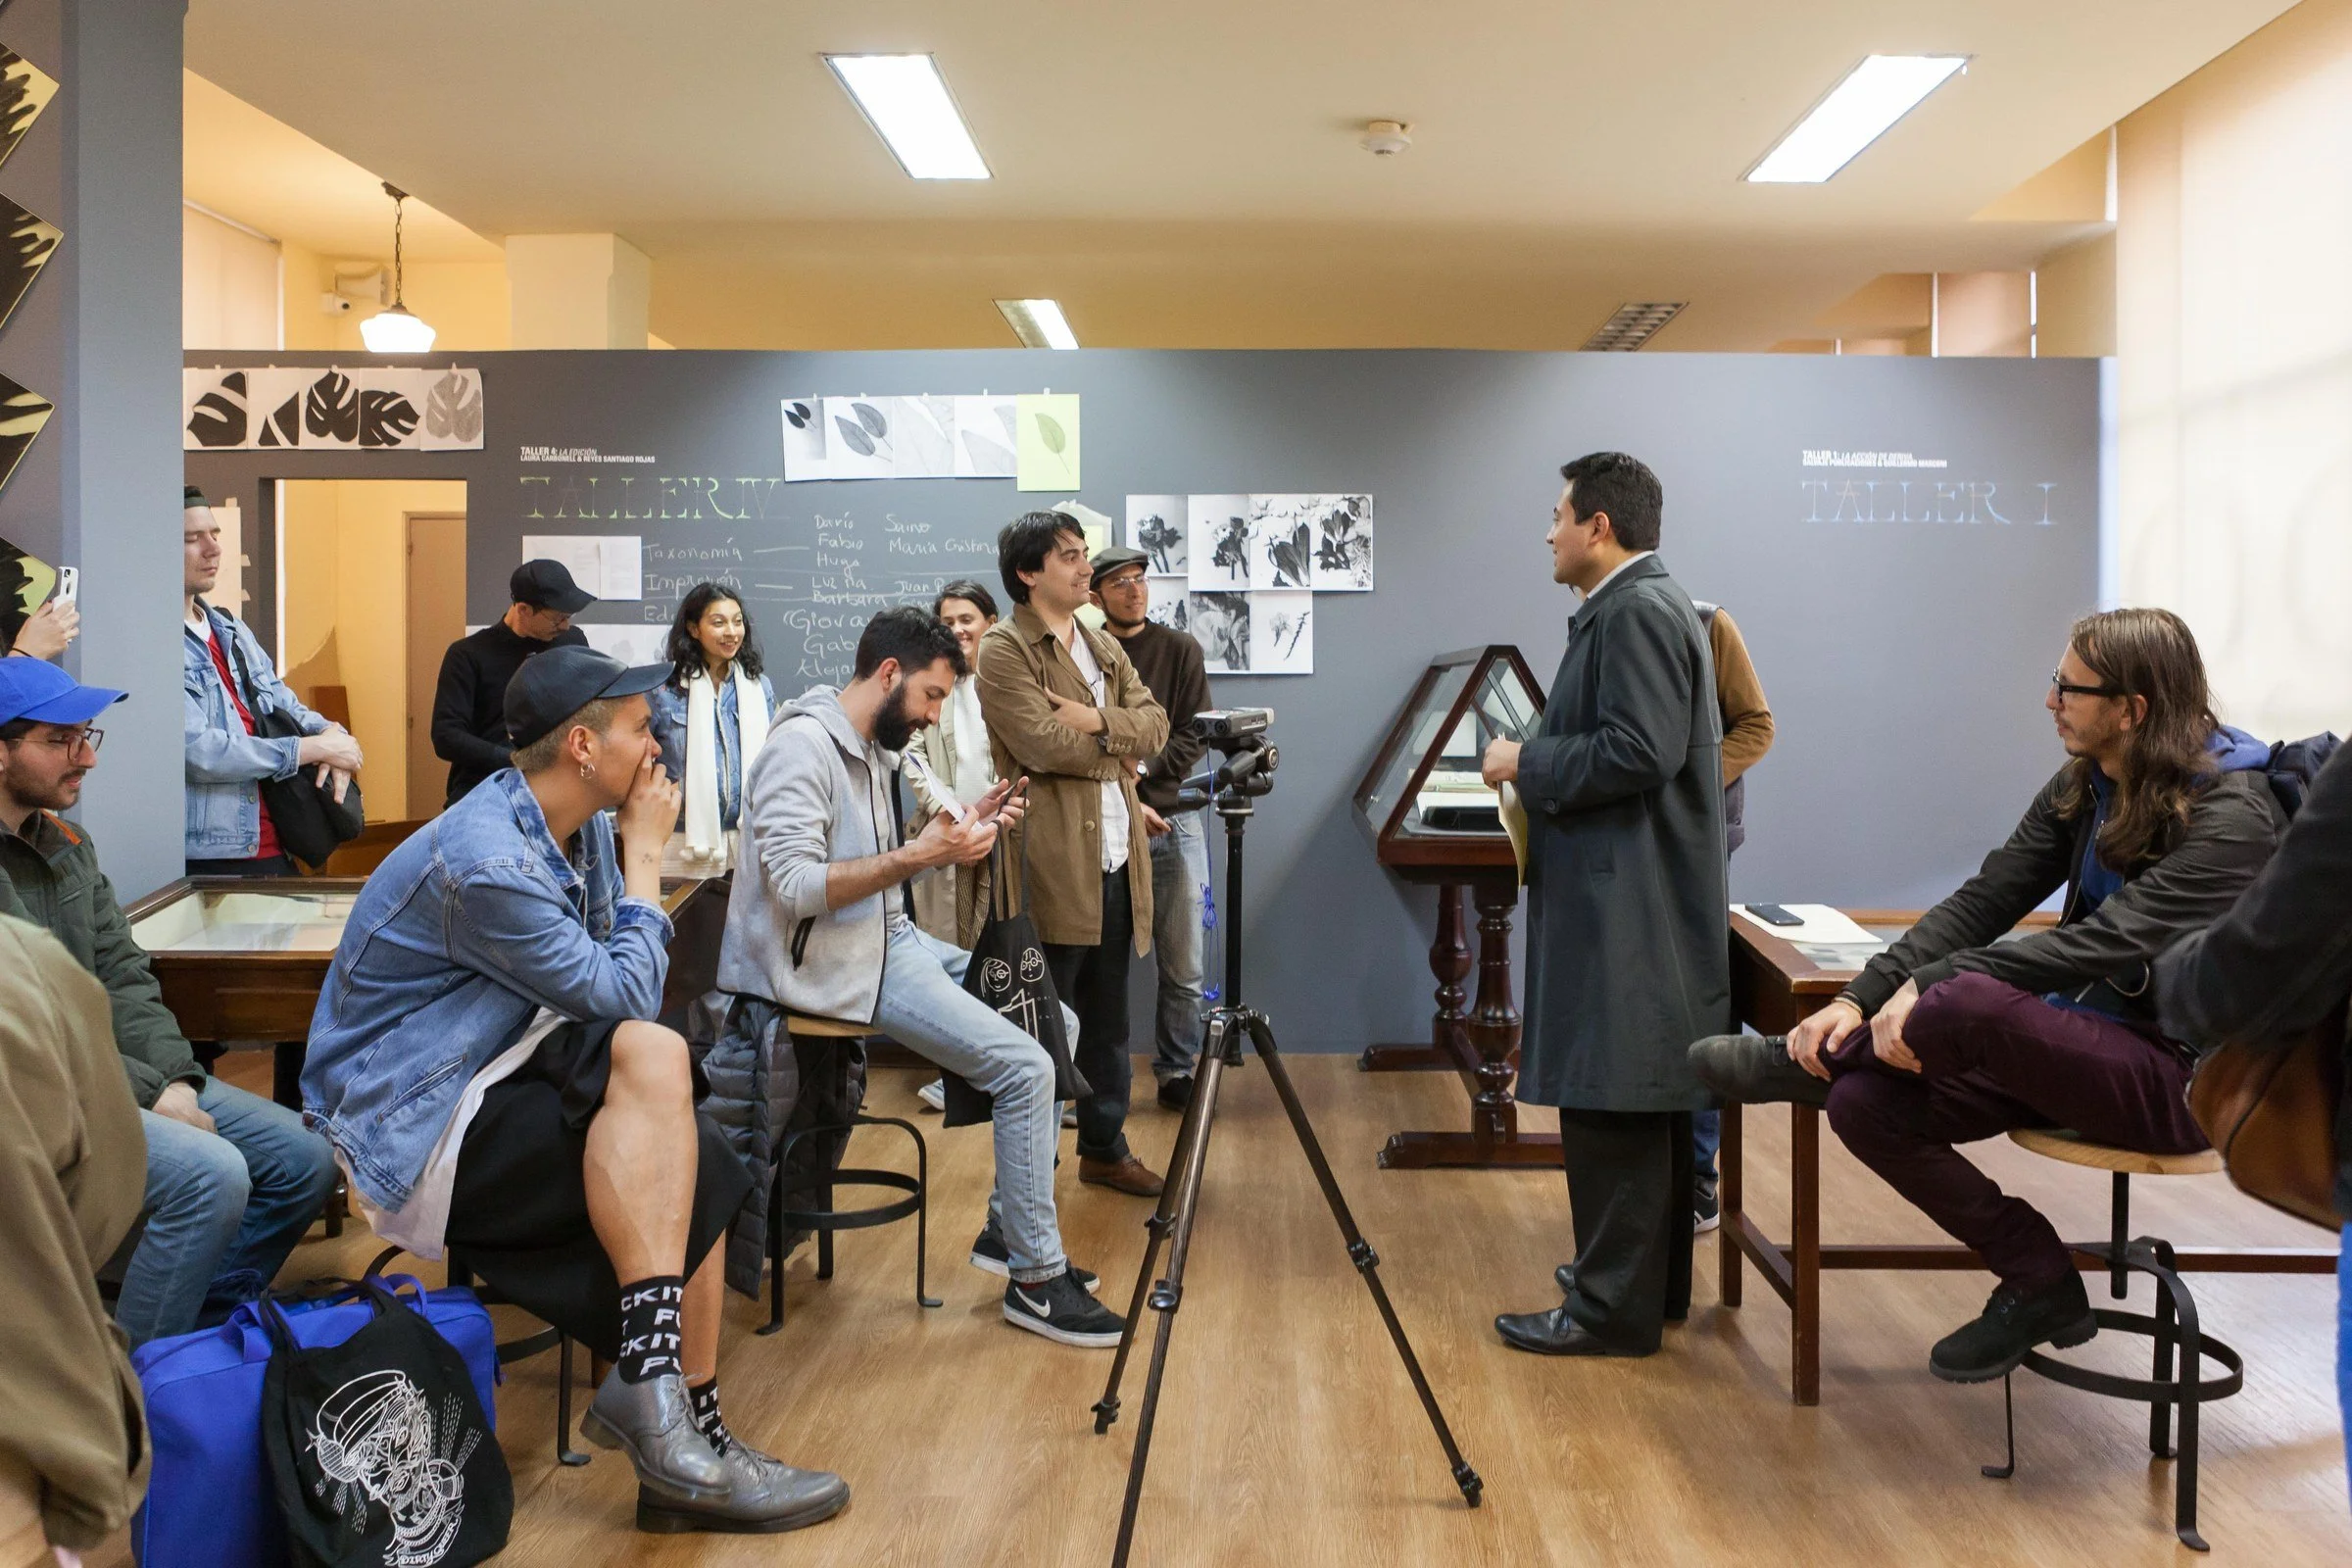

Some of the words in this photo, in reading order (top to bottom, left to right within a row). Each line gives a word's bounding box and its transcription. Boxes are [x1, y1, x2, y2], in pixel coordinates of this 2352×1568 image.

[520, 446, 549, 456] TALLER
[1802, 450, 1832, 461] TALLER
[519, 476, 734, 519] TALLER
[1801, 479, 2011, 525] TALLER
[643, 537, 743, 563] Taxonomía
[621, 1287, 659, 1311] CK
